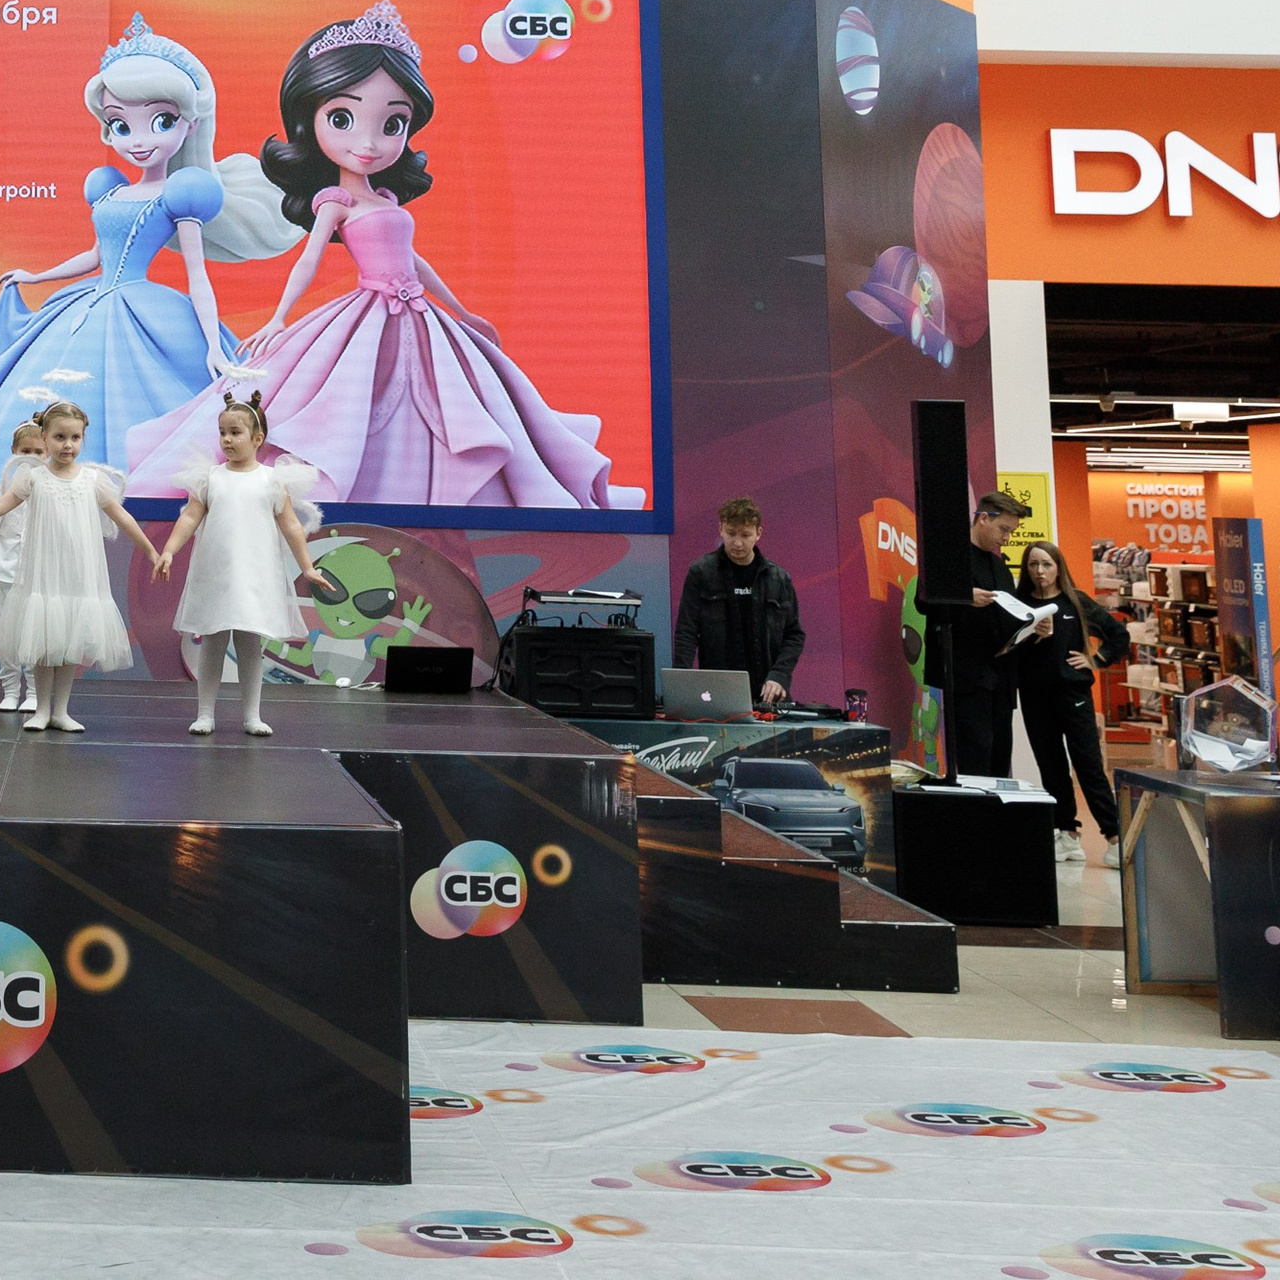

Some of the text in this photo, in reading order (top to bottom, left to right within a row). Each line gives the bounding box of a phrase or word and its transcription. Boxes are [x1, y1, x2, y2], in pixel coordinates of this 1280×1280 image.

[508, 15, 569, 37] СБС
[1050, 128, 1280, 218] DN
[1127, 498, 1206, 520] ПРОВЕ
[878, 520, 917, 566] DNS
[1145, 523, 1208, 544] ТОВА
[1253, 562, 1266, 596] Haier
[444, 874, 518, 904] СБС
[584, 1052, 695, 1065] СБС
[1097, 1071, 1214, 1085] СБС
[410, 1096, 469, 1109] БС
[909, 1112, 1032, 1128] СБС
[683, 1162, 818, 1180] СБС
[416, 1224, 558, 1245] СБС
[1095, 1248, 1248, 1269] СБС
